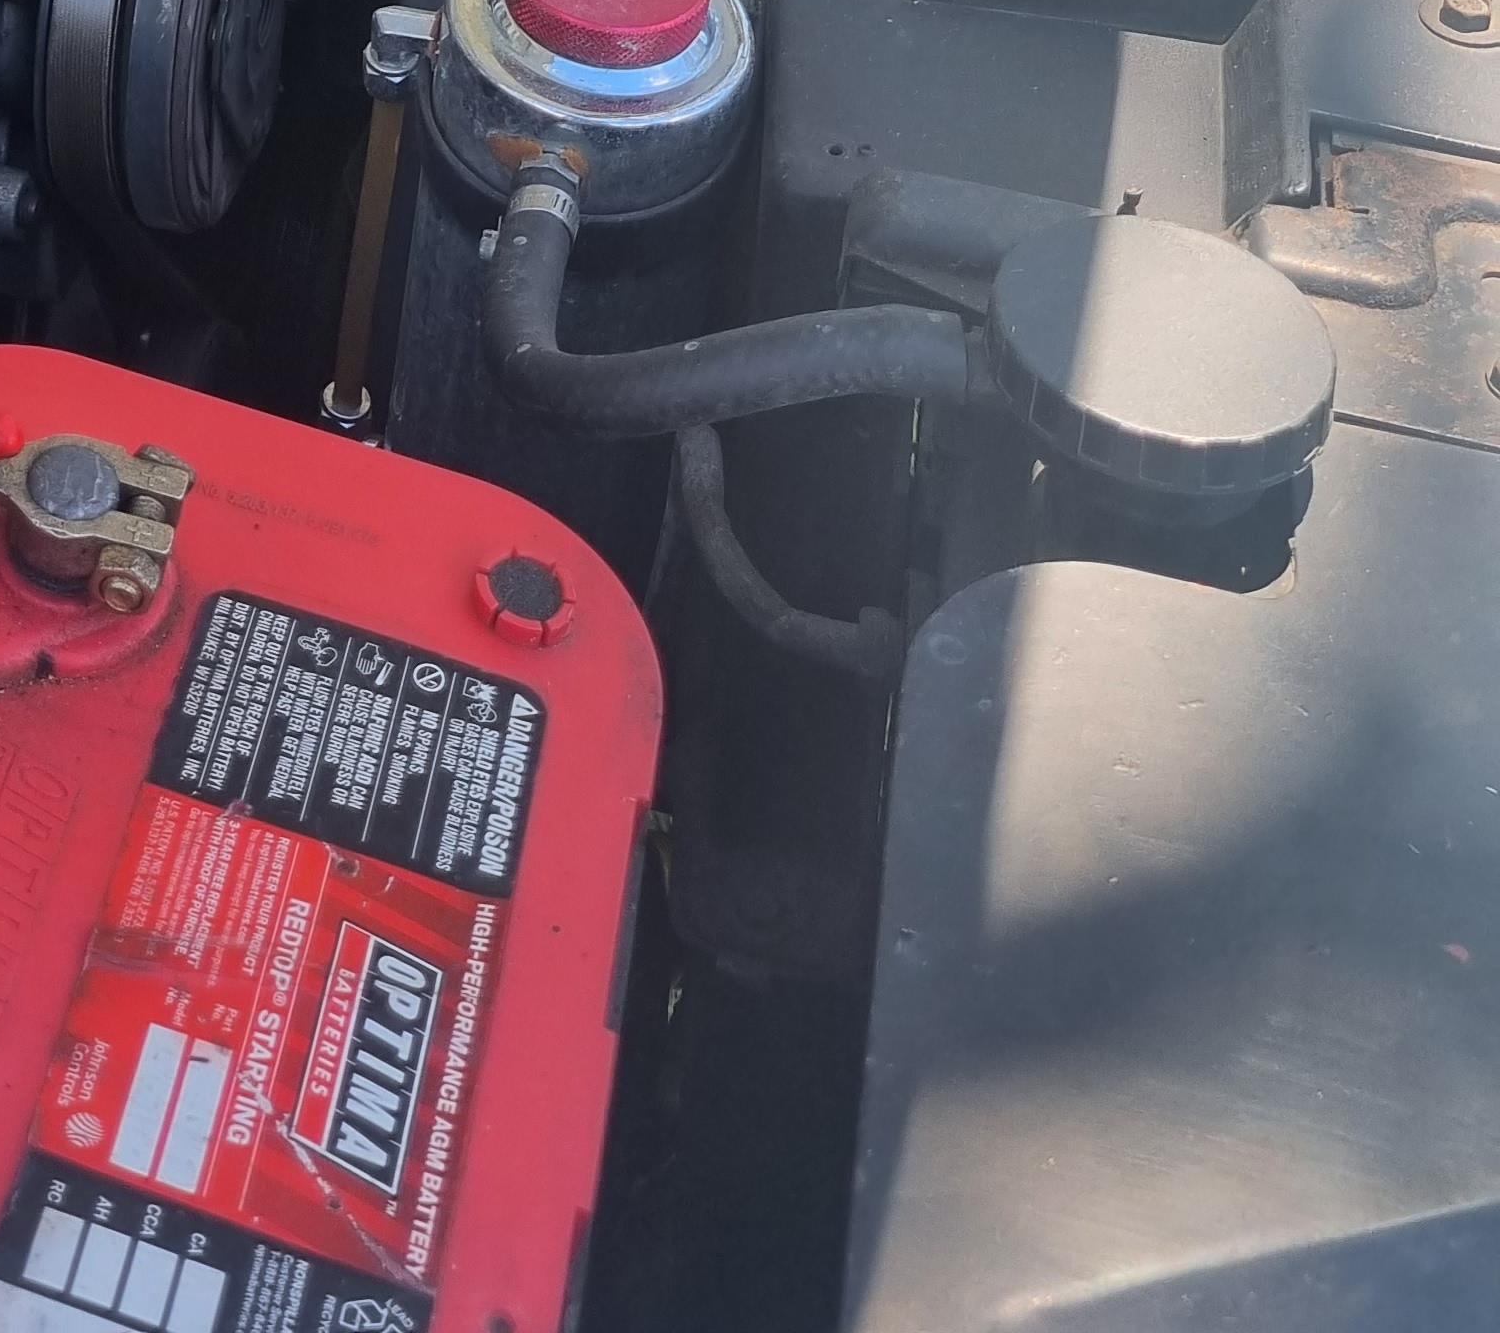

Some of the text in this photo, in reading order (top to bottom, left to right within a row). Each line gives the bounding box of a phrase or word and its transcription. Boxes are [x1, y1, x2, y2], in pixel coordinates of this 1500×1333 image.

[180, 593, 233, 717] MILWAUKEE, WI 53209
[233, 613, 288, 757] KEEP OUT OF THE REACH OF
[178, 600, 249, 785] DIST. BY OPTIMA BATTERIES, INC.
[205, 608, 273, 792] CHILDREN. DO NOT OPEN BATTERY!
[272, 664, 301, 720] HELP FAST.
[322, 682, 357, 766] SEVERE BURNS
[266, 669, 316, 802] WITH WATER. GET MEDICAL
[284, 673, 332, 801] FLUSH EYES IMMEDIATELY
[329, 687, 373, 806] CAUSE BLINDNESS OR
[346, 692, 391, 811] SULFURIC ACID CAN
[380, 702, 418, 806] FLAMES, SMOKING
[406, 708, 438, 778] NO SPARKS,
[438, 716, 465, 773] OR INJURY
[433, 721, 481, 872] GASES CAN CAUSE BLINDNESS
[455, 726, 499, 857] SHIELD EYES EXPLOSIVE
[476, 714, 533, 879] DANGER/POISON
[153, 819, 175, 859] PATENT
[195, 843, 218, 885] PROOF
[207, 815, 227, 846] WITH
[217, 819, 240, 863] 3-YEAR
[261, 830, 275, 844] at
[191, 882, 207, 901] OF
[208, 860, 228, 893] FREE
[240, 835, 290, 977] REGISTER YOUR PRODUCT
[185, 890, 220, 970] REPLACEMENT
[162, 986, 178, 1007] No.
[171, 990, 192, 1027] Model
[210, 1002, 226, 1023] No.
[220, 1006, 238, 1034] Part
[309, 966, 356, 1100] BATTERIES
[335, 953, 427, 1169] OPTIMA
[55, 1040, 90, 1109] Controls
[76, 1037, 112, 1103] Johnson
[225, 1007, 283, 1149] STARTING
[402, 899, 495, 1281] HIGH-PERFORMANCE AGM BATTERY
[47, 1179, 66, 1204] RC
[92, 1195, 115, 1221] AH
[139, 1203, 162, 1236] CCA
[187, 1232, 206, 1256] CA
[384, 1297, 416, 1329] LEAD
